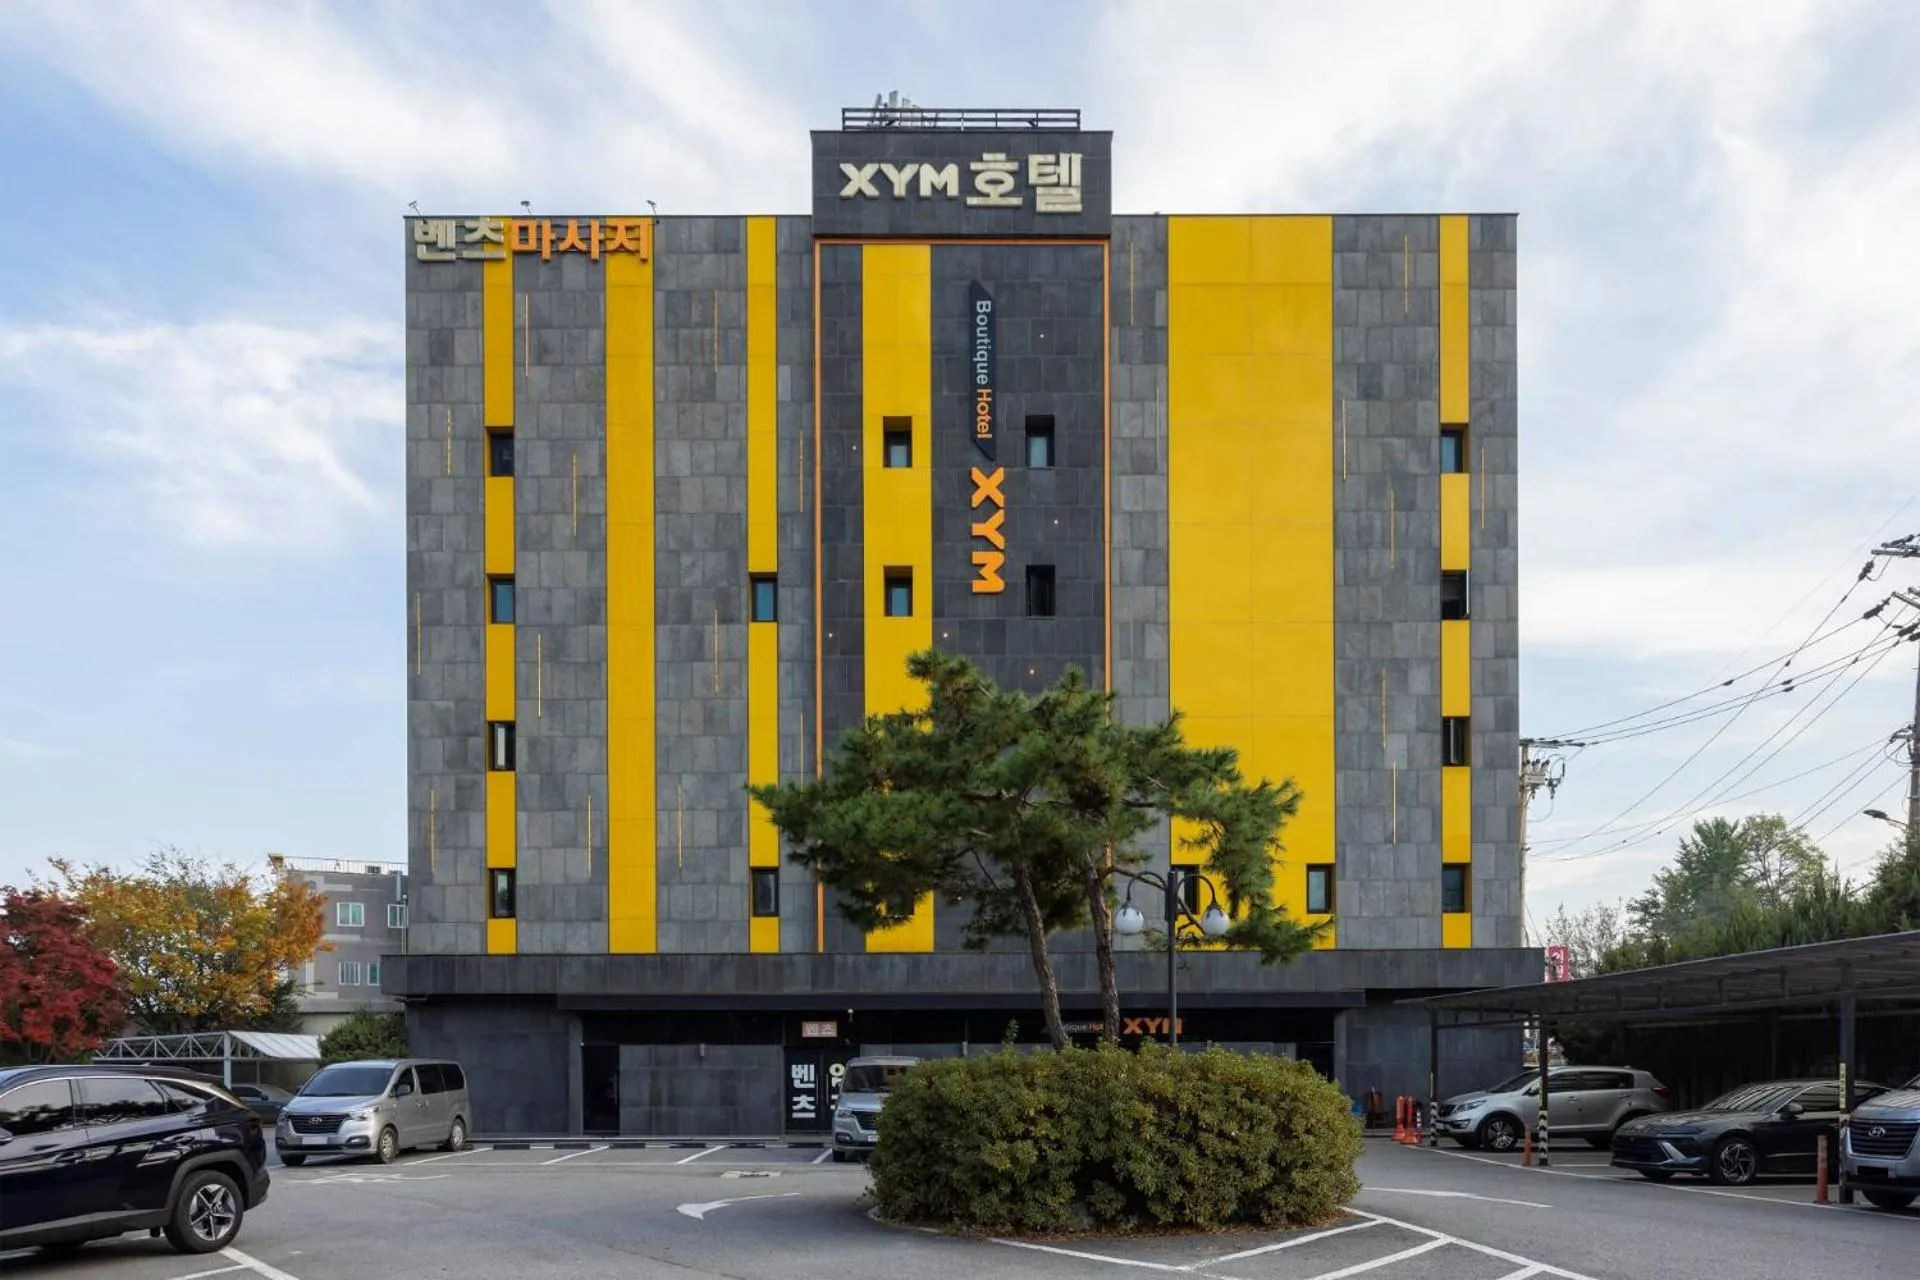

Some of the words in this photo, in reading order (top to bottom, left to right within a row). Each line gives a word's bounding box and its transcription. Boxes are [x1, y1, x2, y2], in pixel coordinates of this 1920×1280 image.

[839, 163, 959, 197] XYM
[966, 153, 1083, 213] 호텔
[413, 217, 506, 262] 벤츠
[510, 217, 649, 262] 마사지
[975, 300, 992, 385] Boutique
[976, 388, 993, 439] Hotel
[971, 467, 1005, 593] XYM
[807, 1023, 834, 1035] 벤츠
[1123, 1017, 1183, 1034] XYM
[791, 1064, 816, 1118] 벤츠
